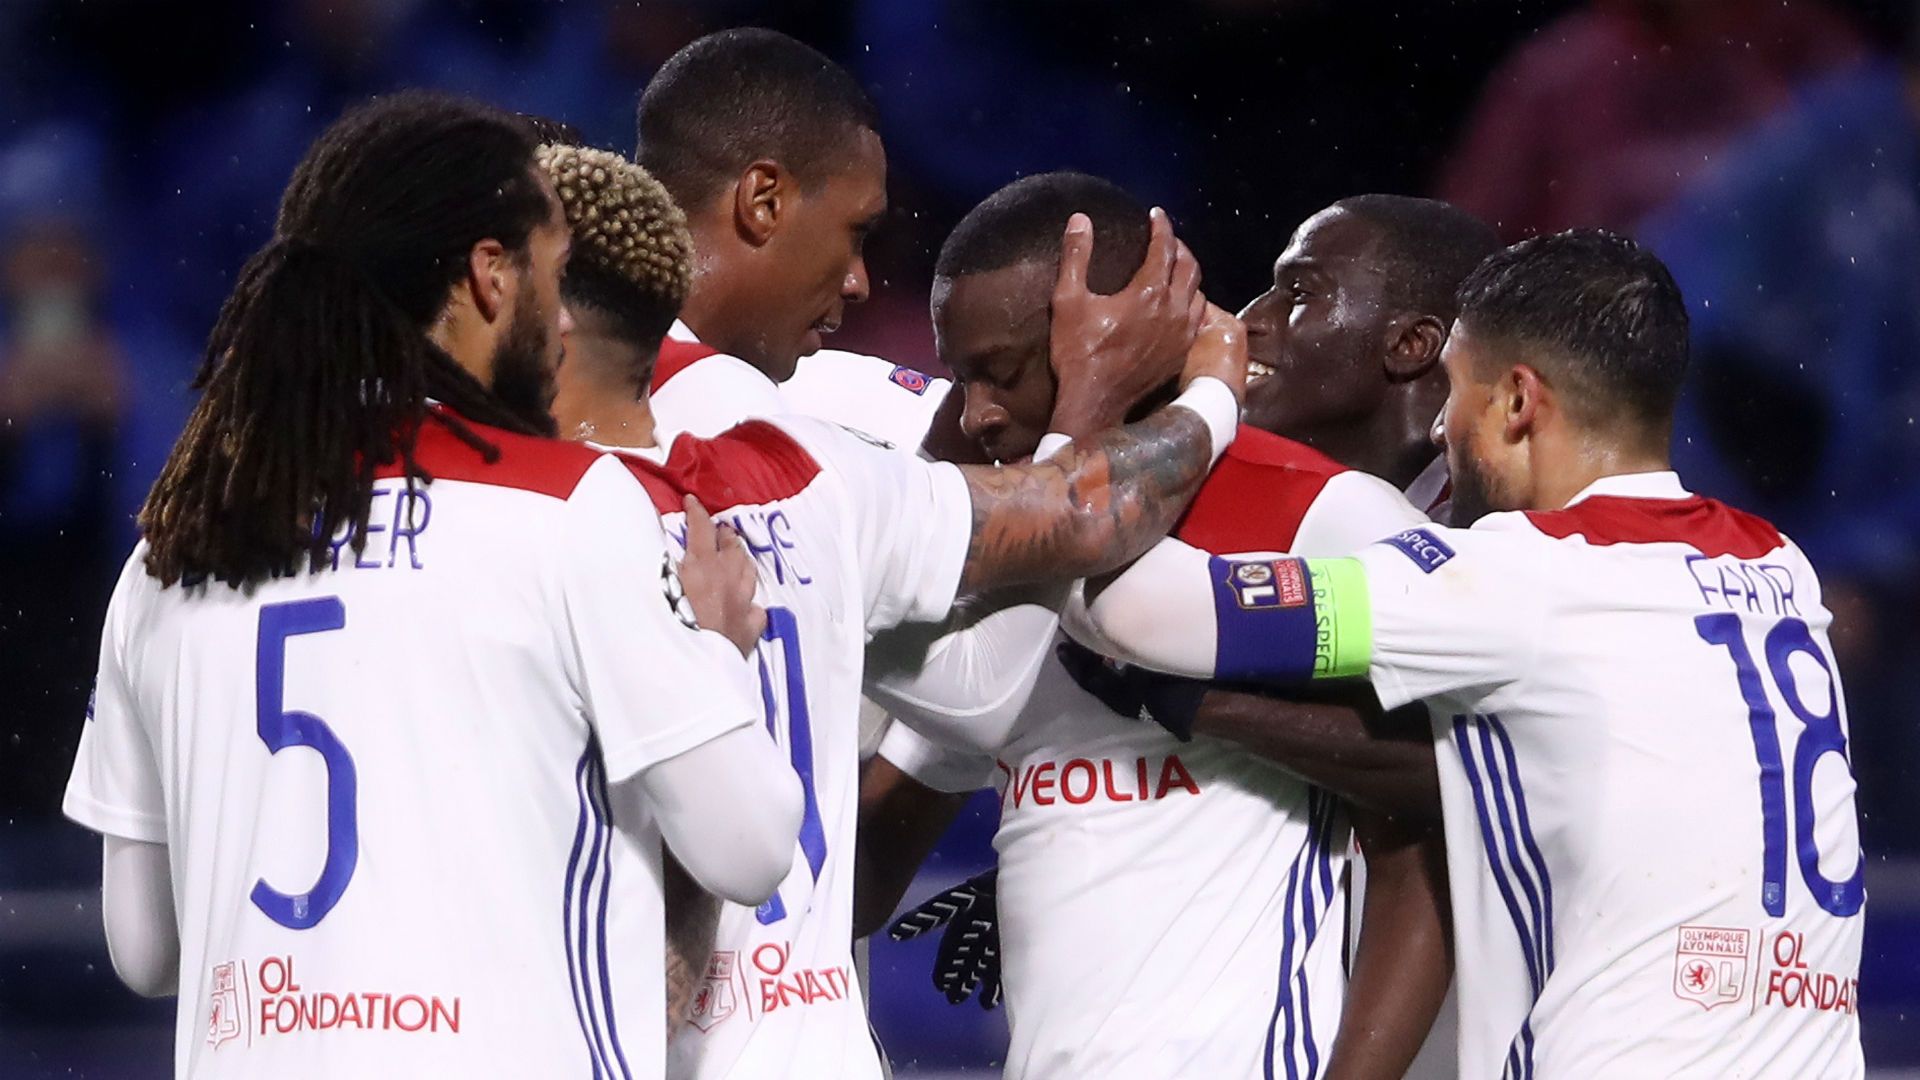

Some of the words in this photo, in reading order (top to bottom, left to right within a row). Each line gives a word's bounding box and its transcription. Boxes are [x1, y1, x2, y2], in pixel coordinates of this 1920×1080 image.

[1397, 531, 1448, 565] SPECT
[250, 595, 359, 930] 5
[1013, 754, 1200, 809] VEOLIA
[1694, 612, 1865, 917] 18
[1683, 941, 1743, 954] LYONNAIS
[1684, 930, 1744, 943] OLYMPIQUE
[1774, 930, 1806, 969] OL
[259, 955, 300, 994] OL
[260, 992, 460, 1035] FONDATION
